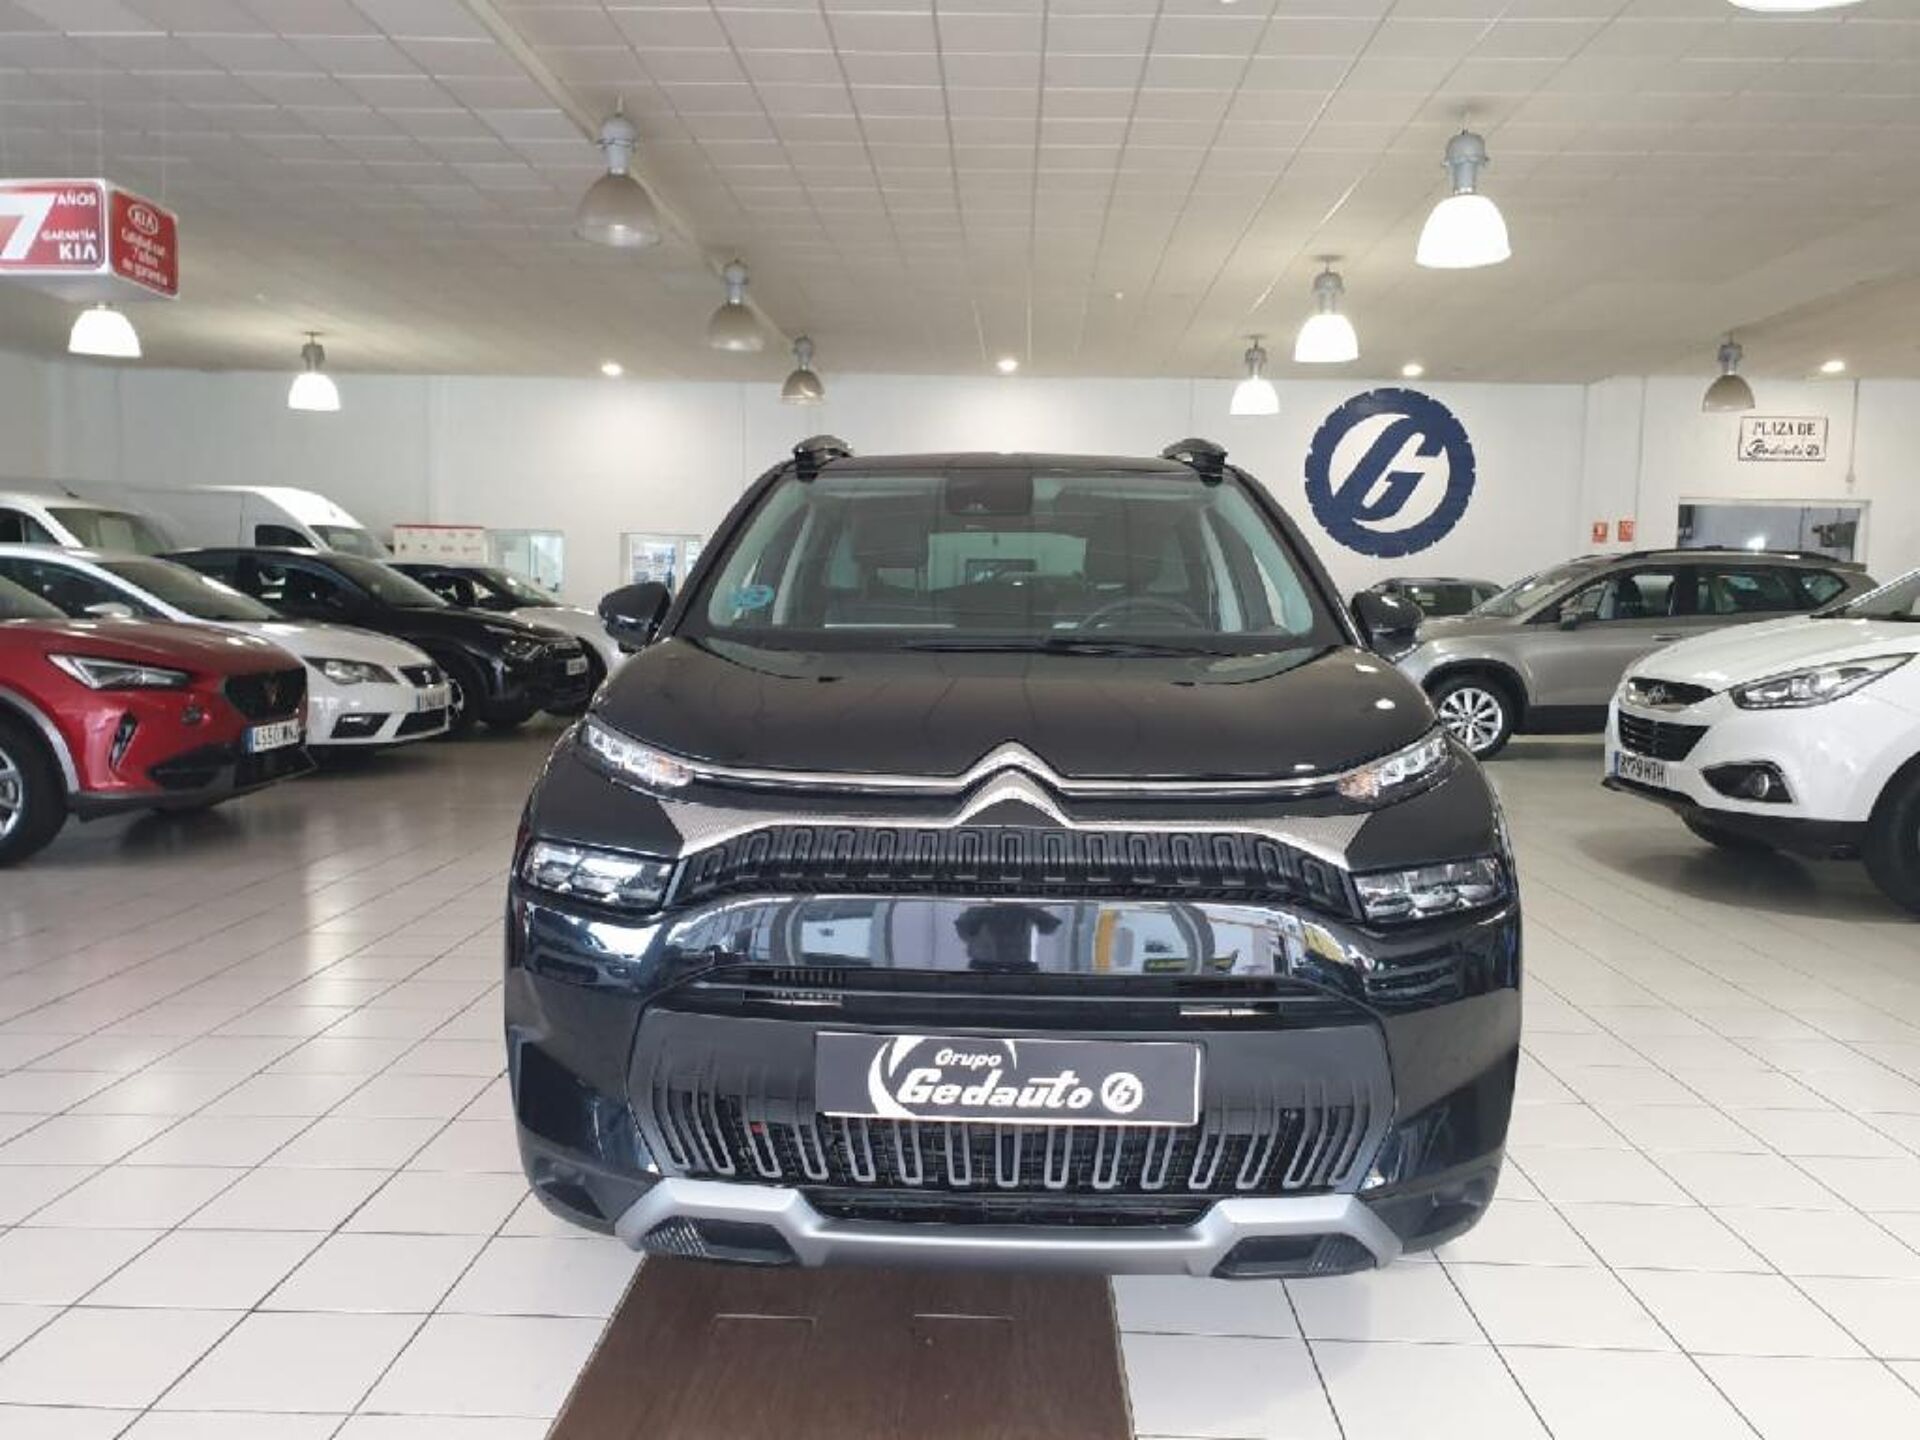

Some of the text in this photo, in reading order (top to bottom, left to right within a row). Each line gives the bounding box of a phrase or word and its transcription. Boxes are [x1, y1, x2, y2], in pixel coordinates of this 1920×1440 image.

[57, 189, 97, 206] AÑOS
[0, 192, 57, 260] 7
[59, 243, 98, 260] KIA
[1753, 421, 1816, 436] PLAZA DE
[935, 1048, 1002, 1071] Grupo
[896, 1067, 1094, 1109] Gedauto
